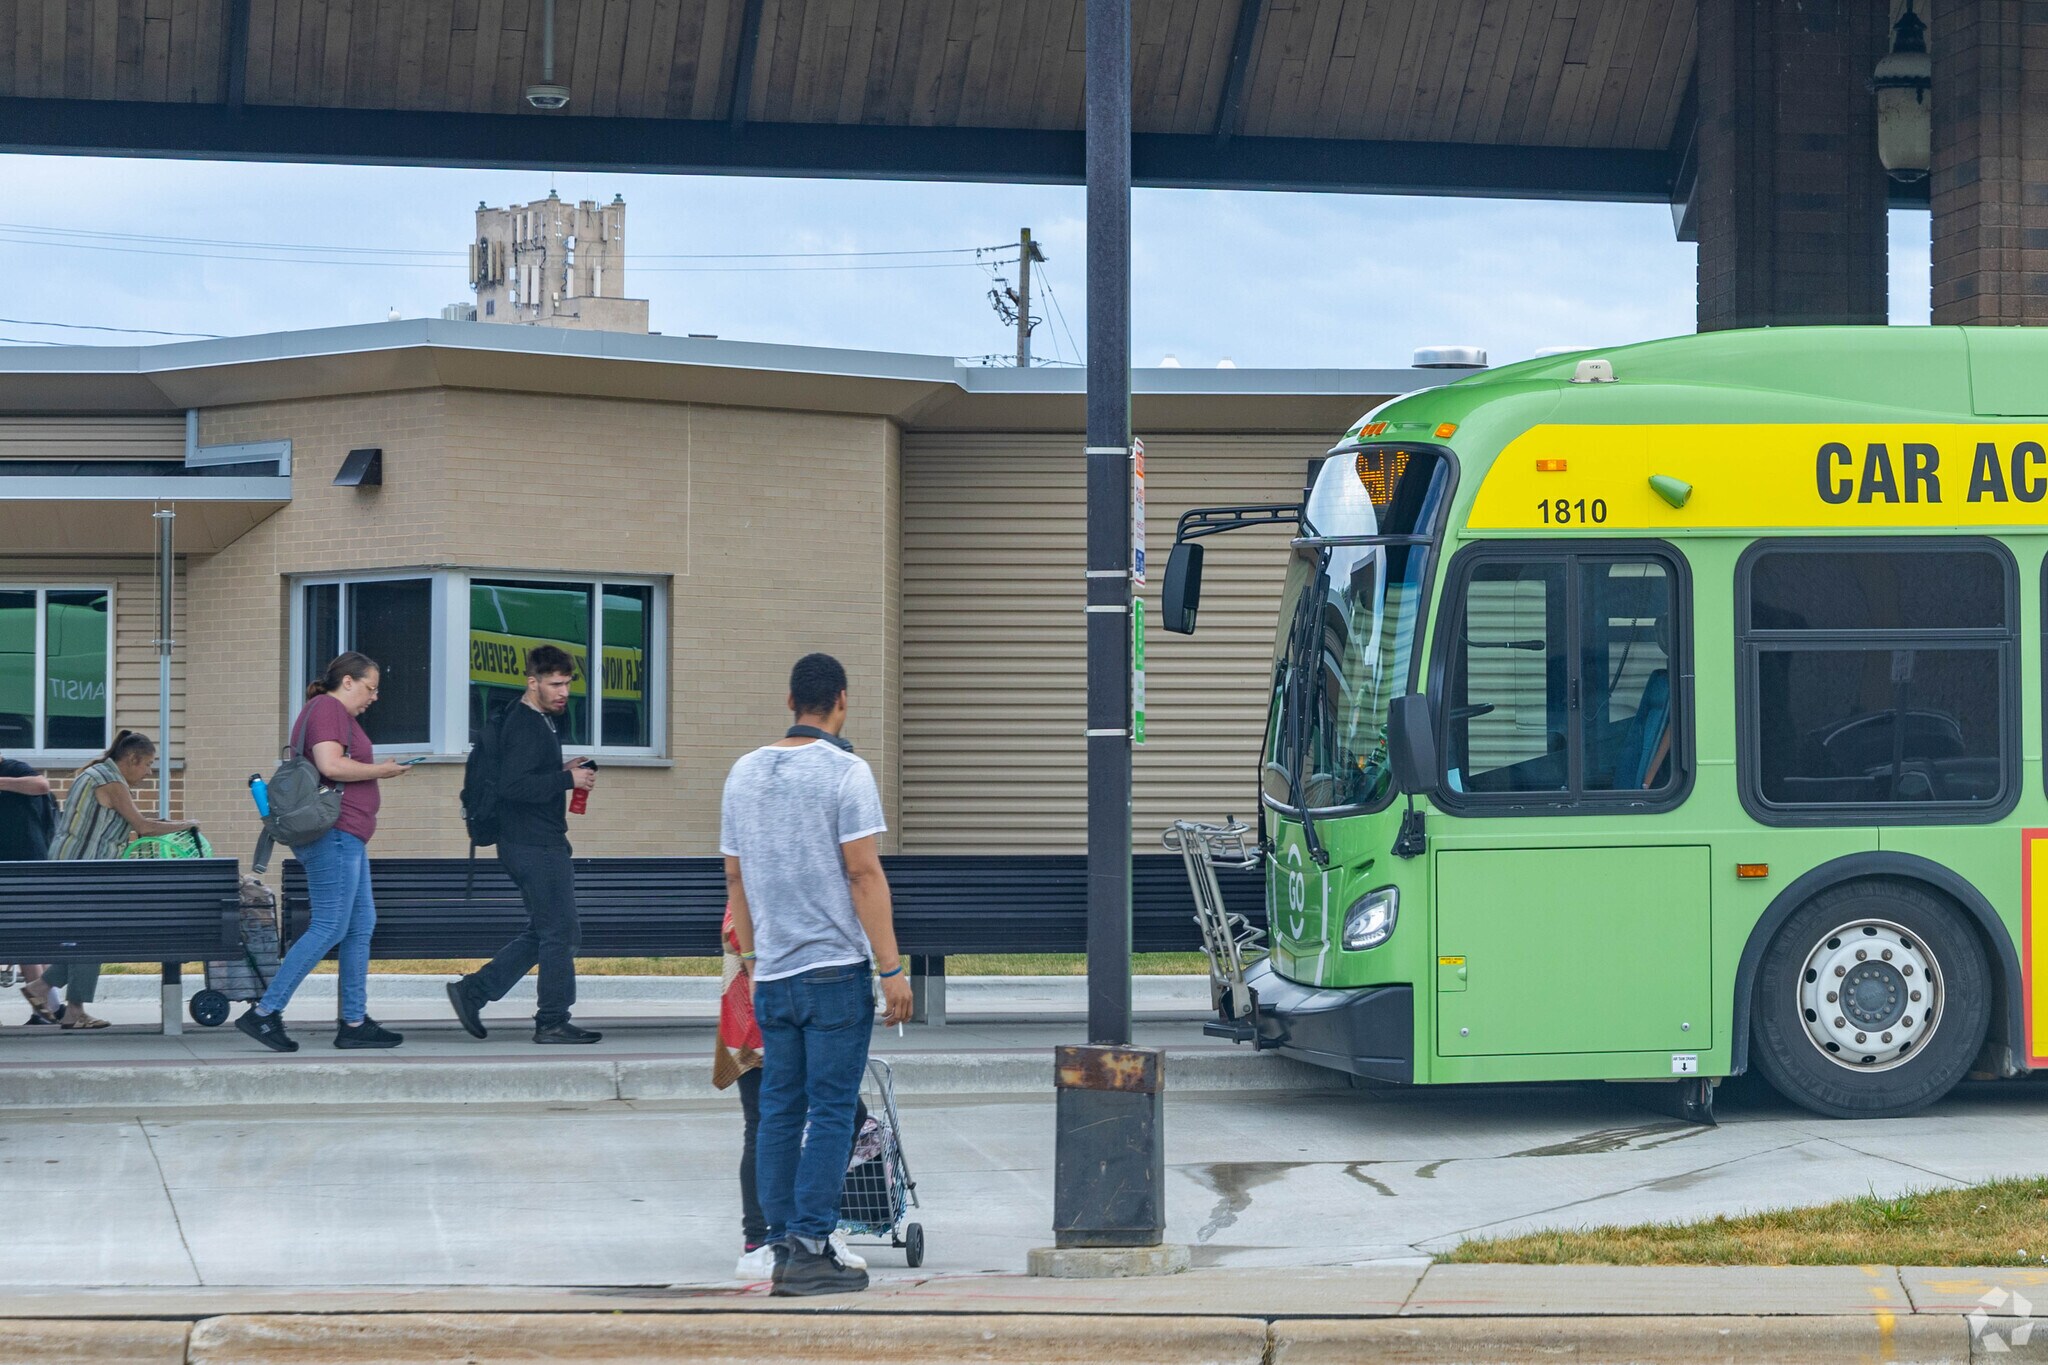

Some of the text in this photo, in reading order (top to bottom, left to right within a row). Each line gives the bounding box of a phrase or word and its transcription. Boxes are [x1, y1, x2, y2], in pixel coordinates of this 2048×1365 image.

[1816, 441, 2048, 504] CAR AC
[1537, 498, 1607, 524] 1810
[1288, 871, 1305, 912] GO
